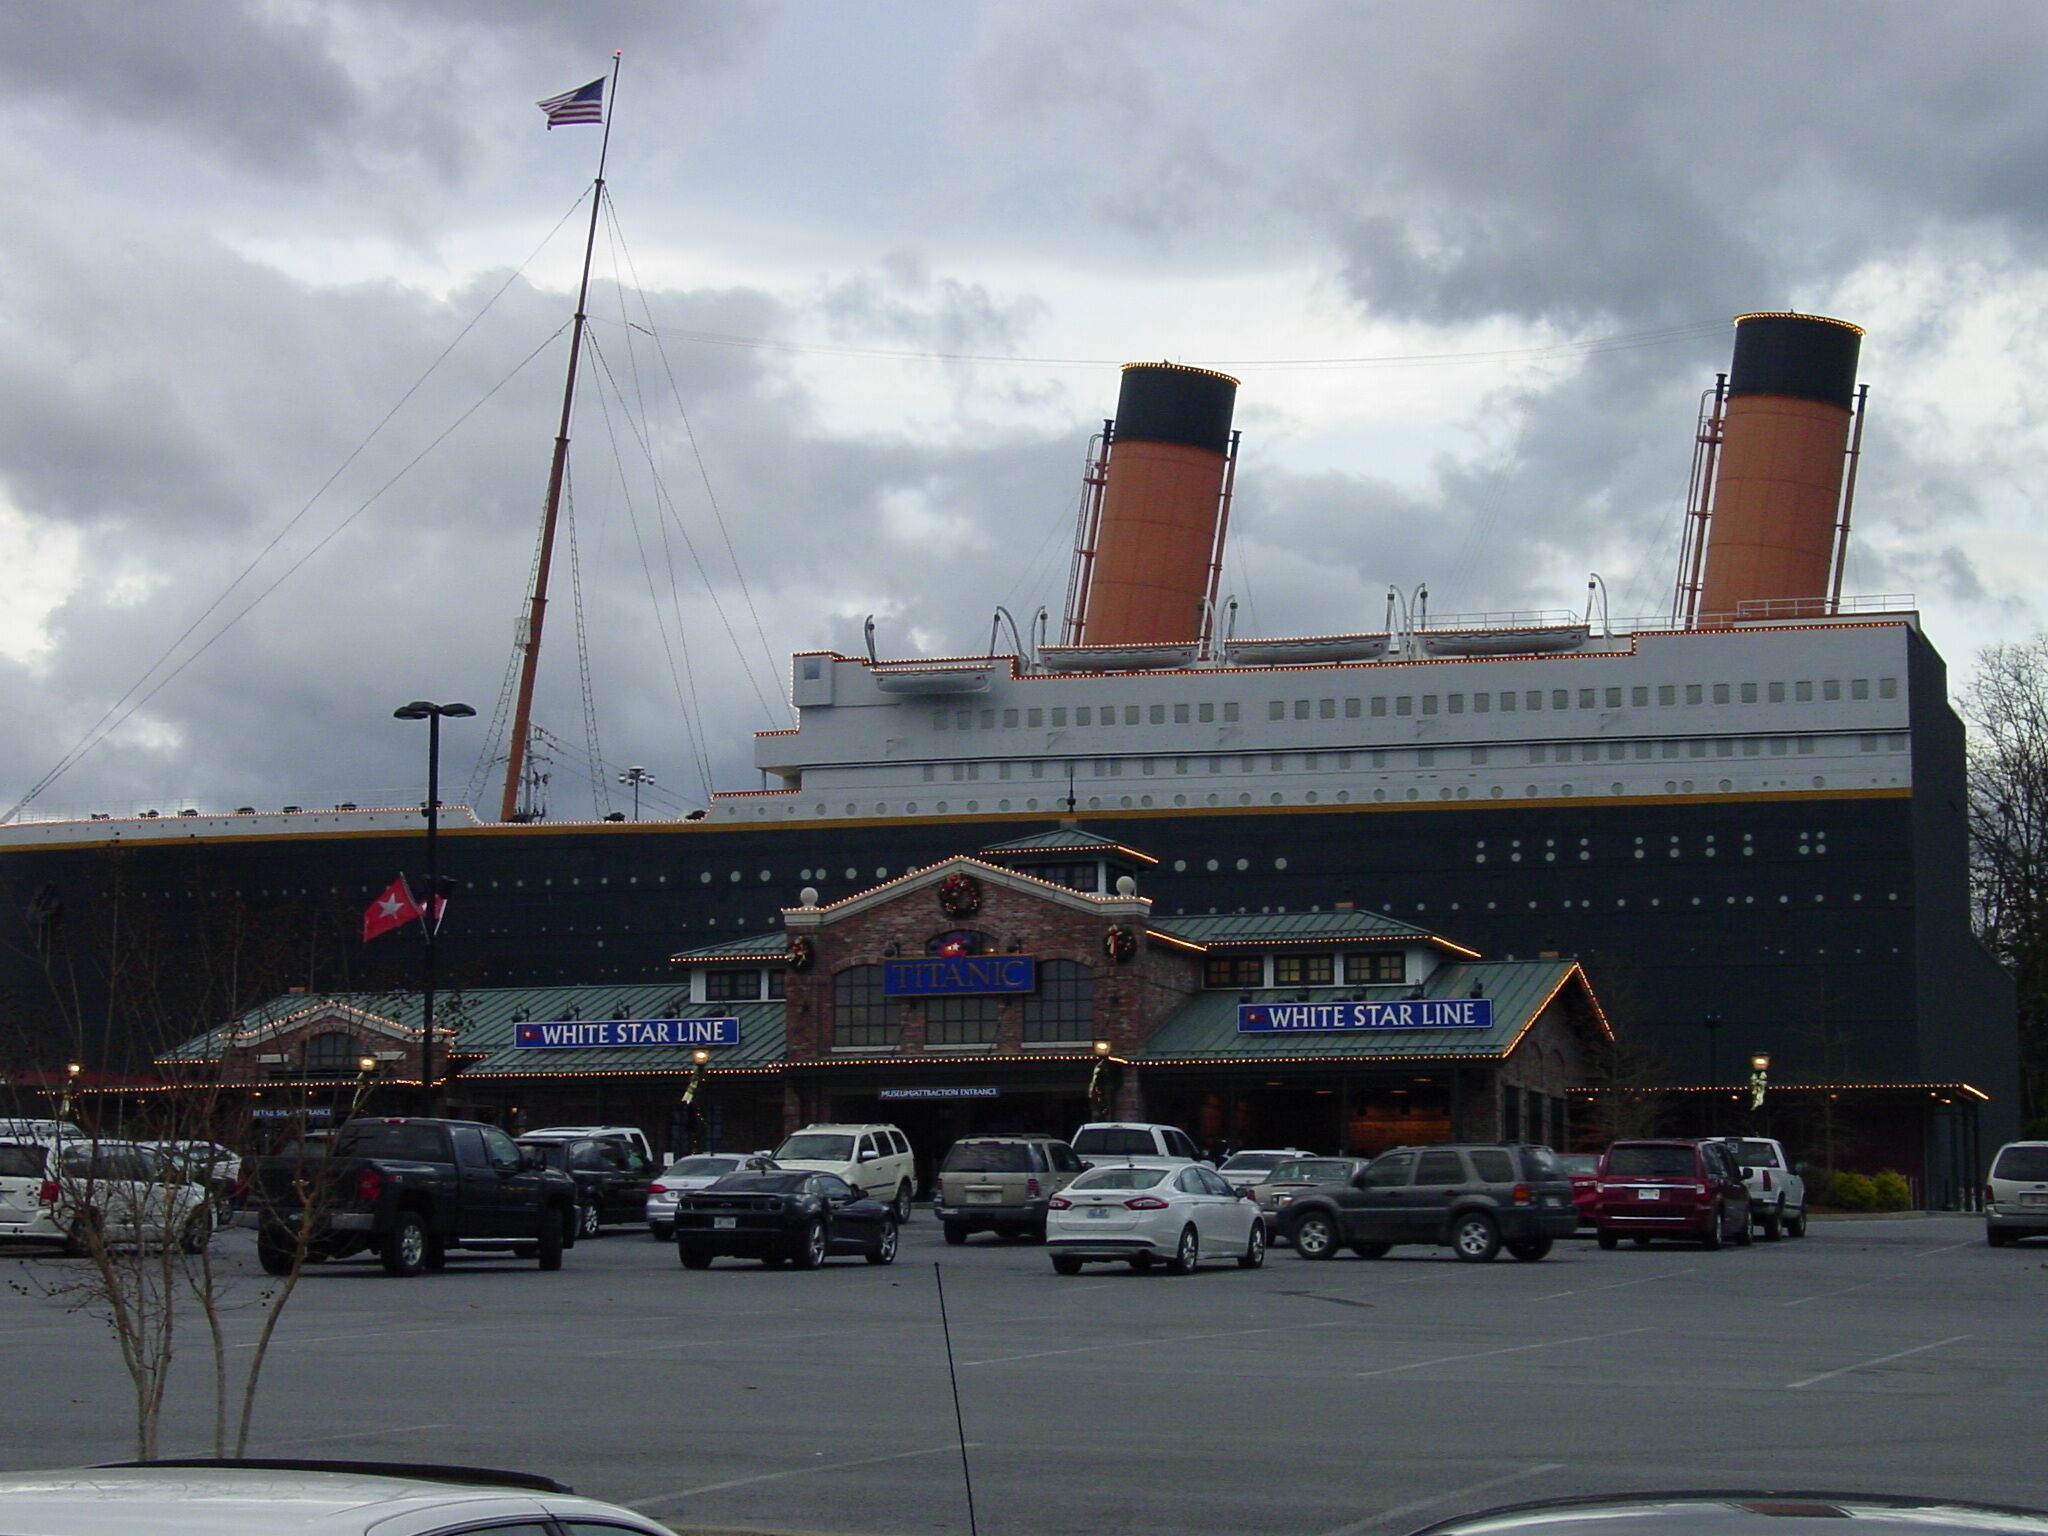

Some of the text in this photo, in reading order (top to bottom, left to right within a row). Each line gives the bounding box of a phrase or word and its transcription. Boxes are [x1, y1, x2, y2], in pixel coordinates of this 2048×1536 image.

[892, 960, 1025, 989] TITANIC
[1268, 1003, 1476, 1028] WHITE STAR LINE
[542, 1021, 725, 1045] WHITE STAR LINE
[960, 1087, 997, 1096] ENTRANCE
